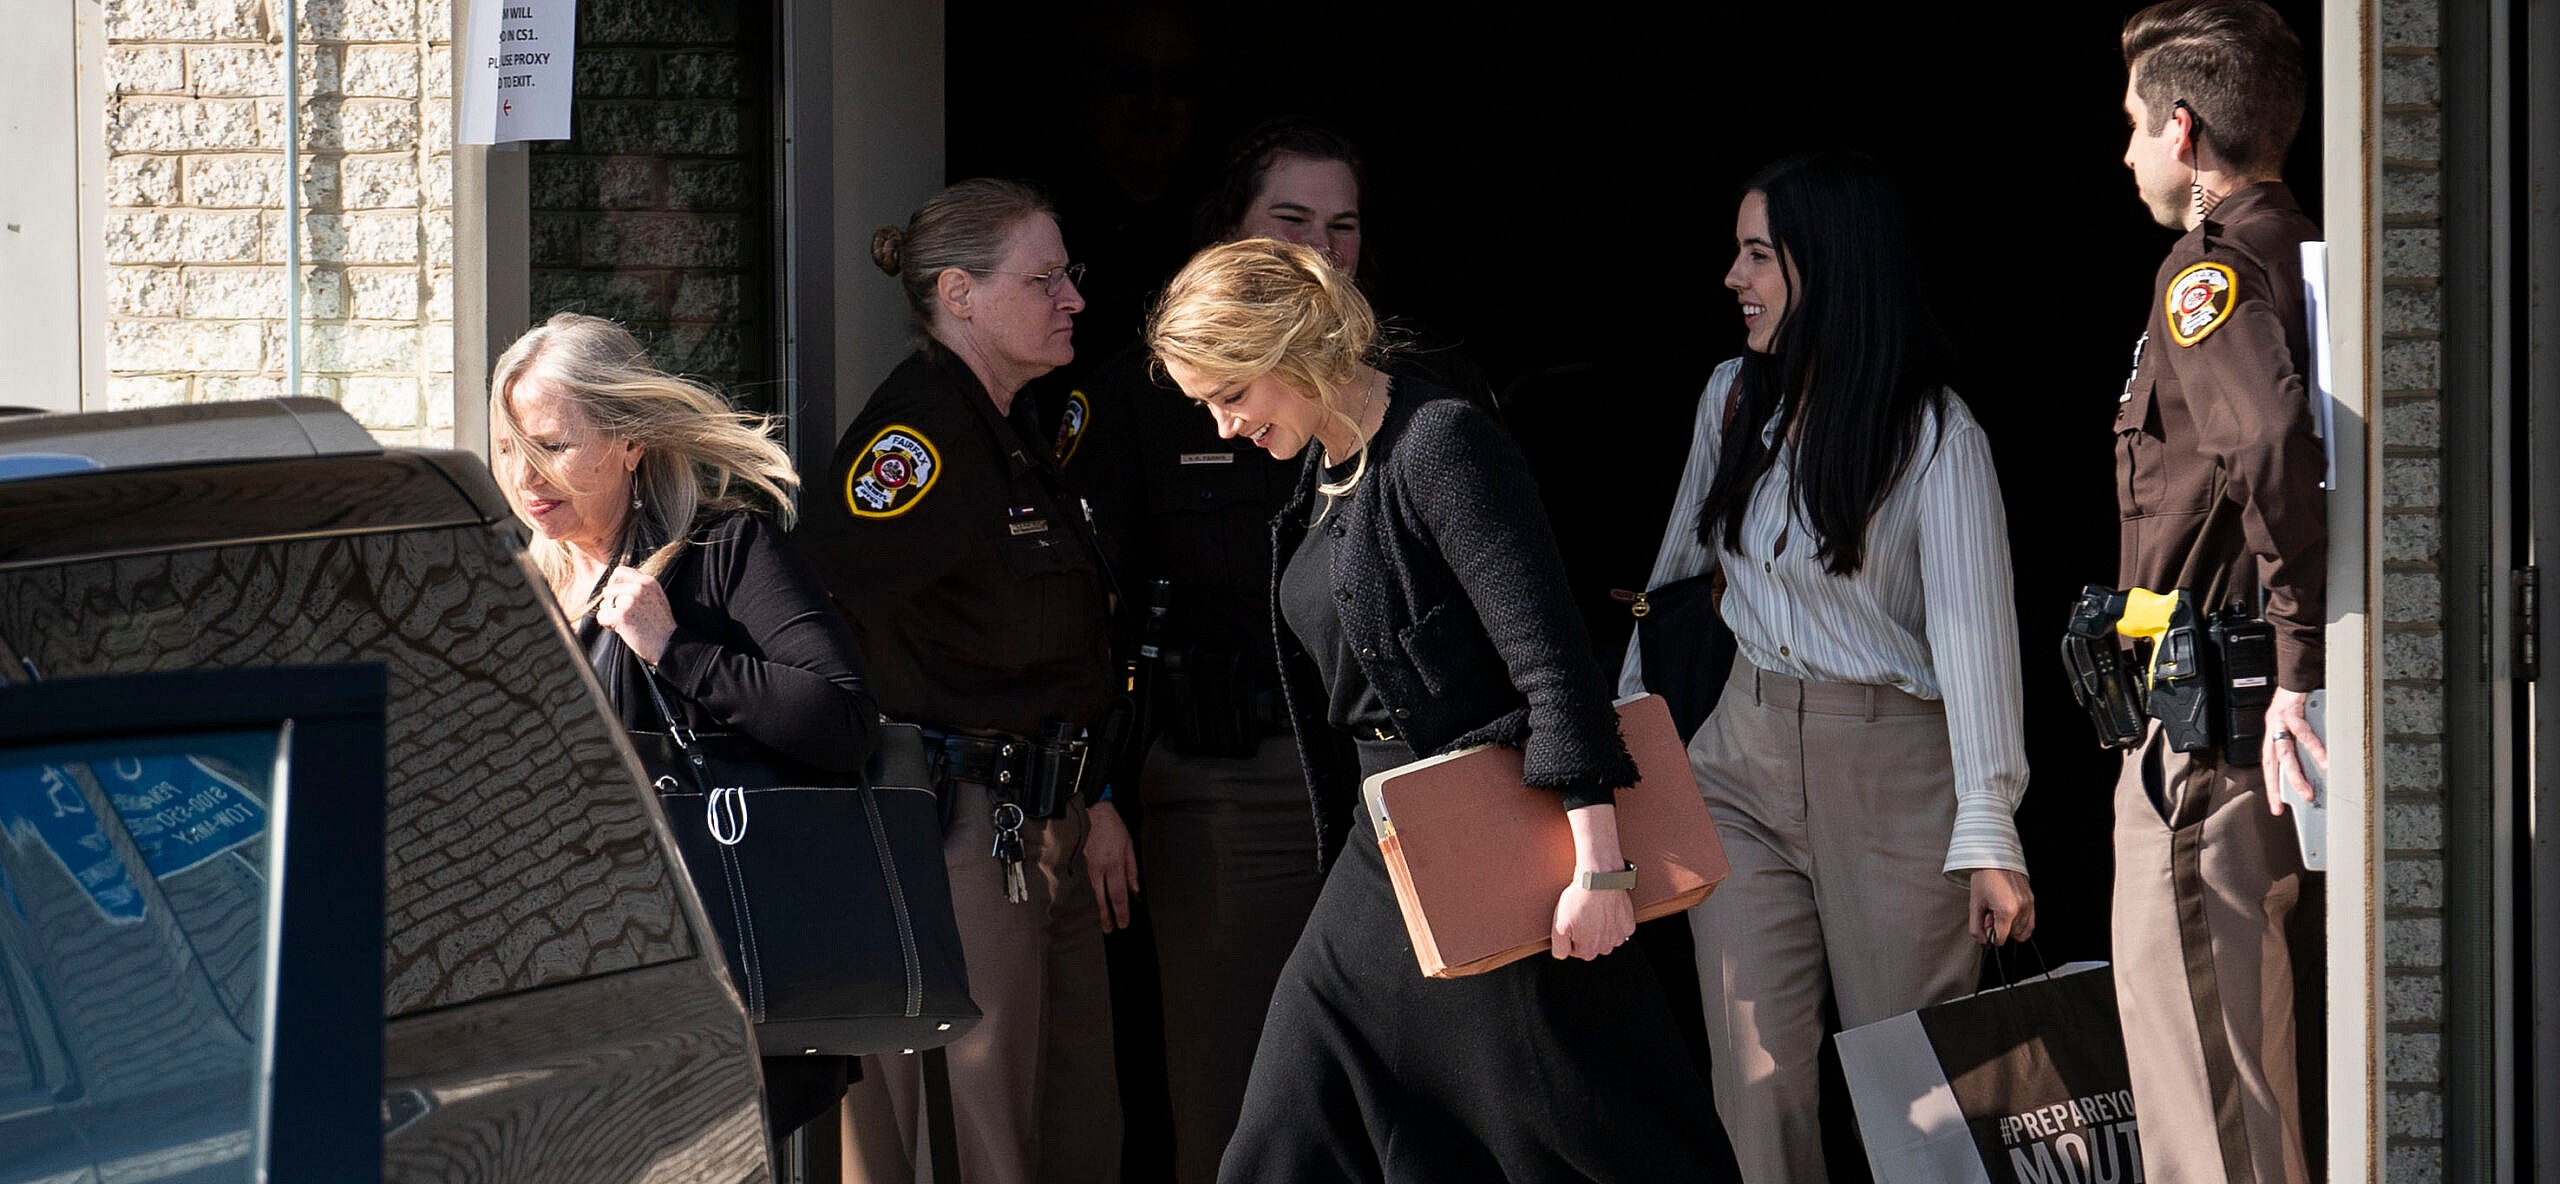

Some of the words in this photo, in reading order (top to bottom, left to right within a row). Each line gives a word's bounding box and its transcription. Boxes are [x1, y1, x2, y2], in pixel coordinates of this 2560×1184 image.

[510, 7, 533, 19] WILL
[516, 29, 538, 41] CS1.
[514, 53, 550, 66] PROXY
[513, 75, 535, 88] EXIT.
[892, 436, 928, 466] FAIRFAX
[2000, 1089, 2135, 1145] #PREPAREYO
[2008, 1120, 2144, 1184] MOUT
